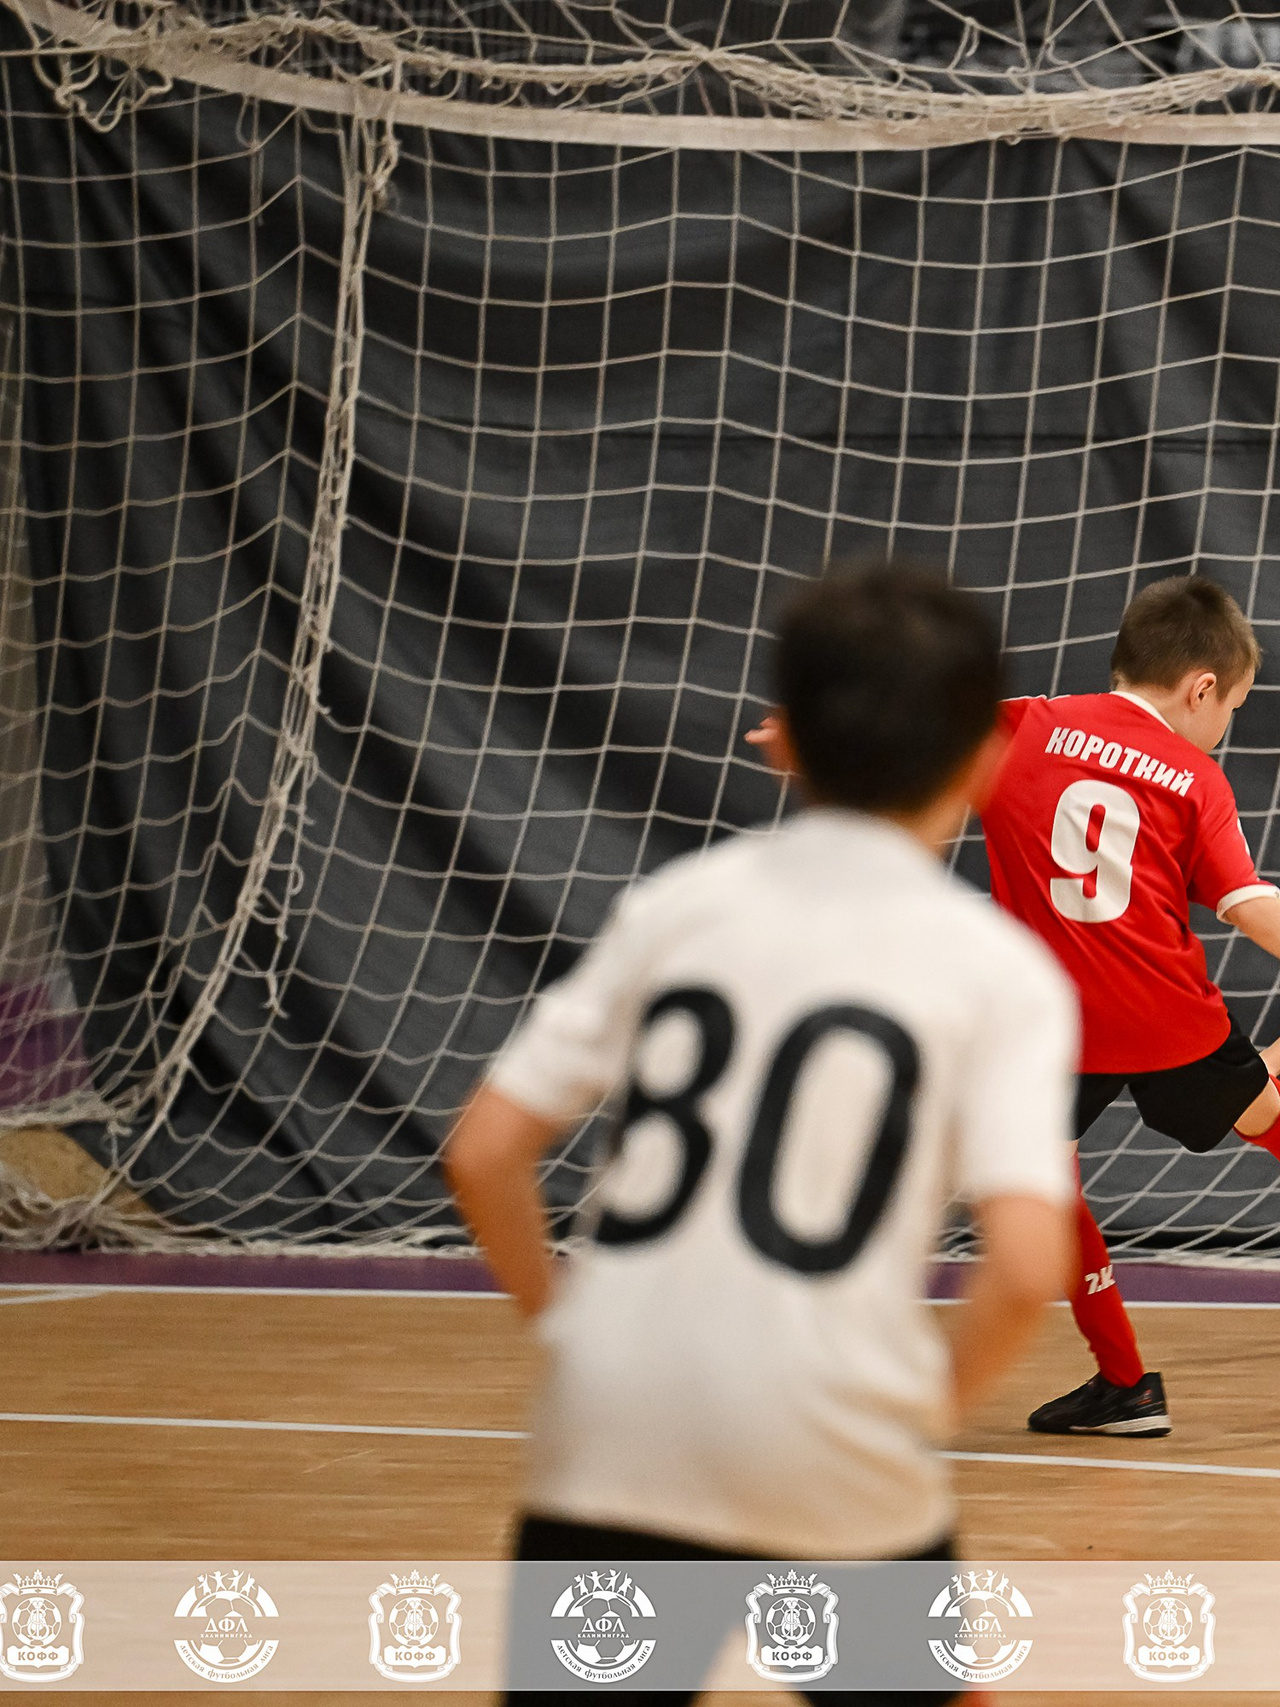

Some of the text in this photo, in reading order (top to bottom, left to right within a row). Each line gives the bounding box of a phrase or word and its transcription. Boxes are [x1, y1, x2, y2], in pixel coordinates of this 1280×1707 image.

[1044, 726, 1194, 798] КОРОТКИЙ
[1050, 779, 1140, 924] 9
[592, 985, 922, 1275] 80
